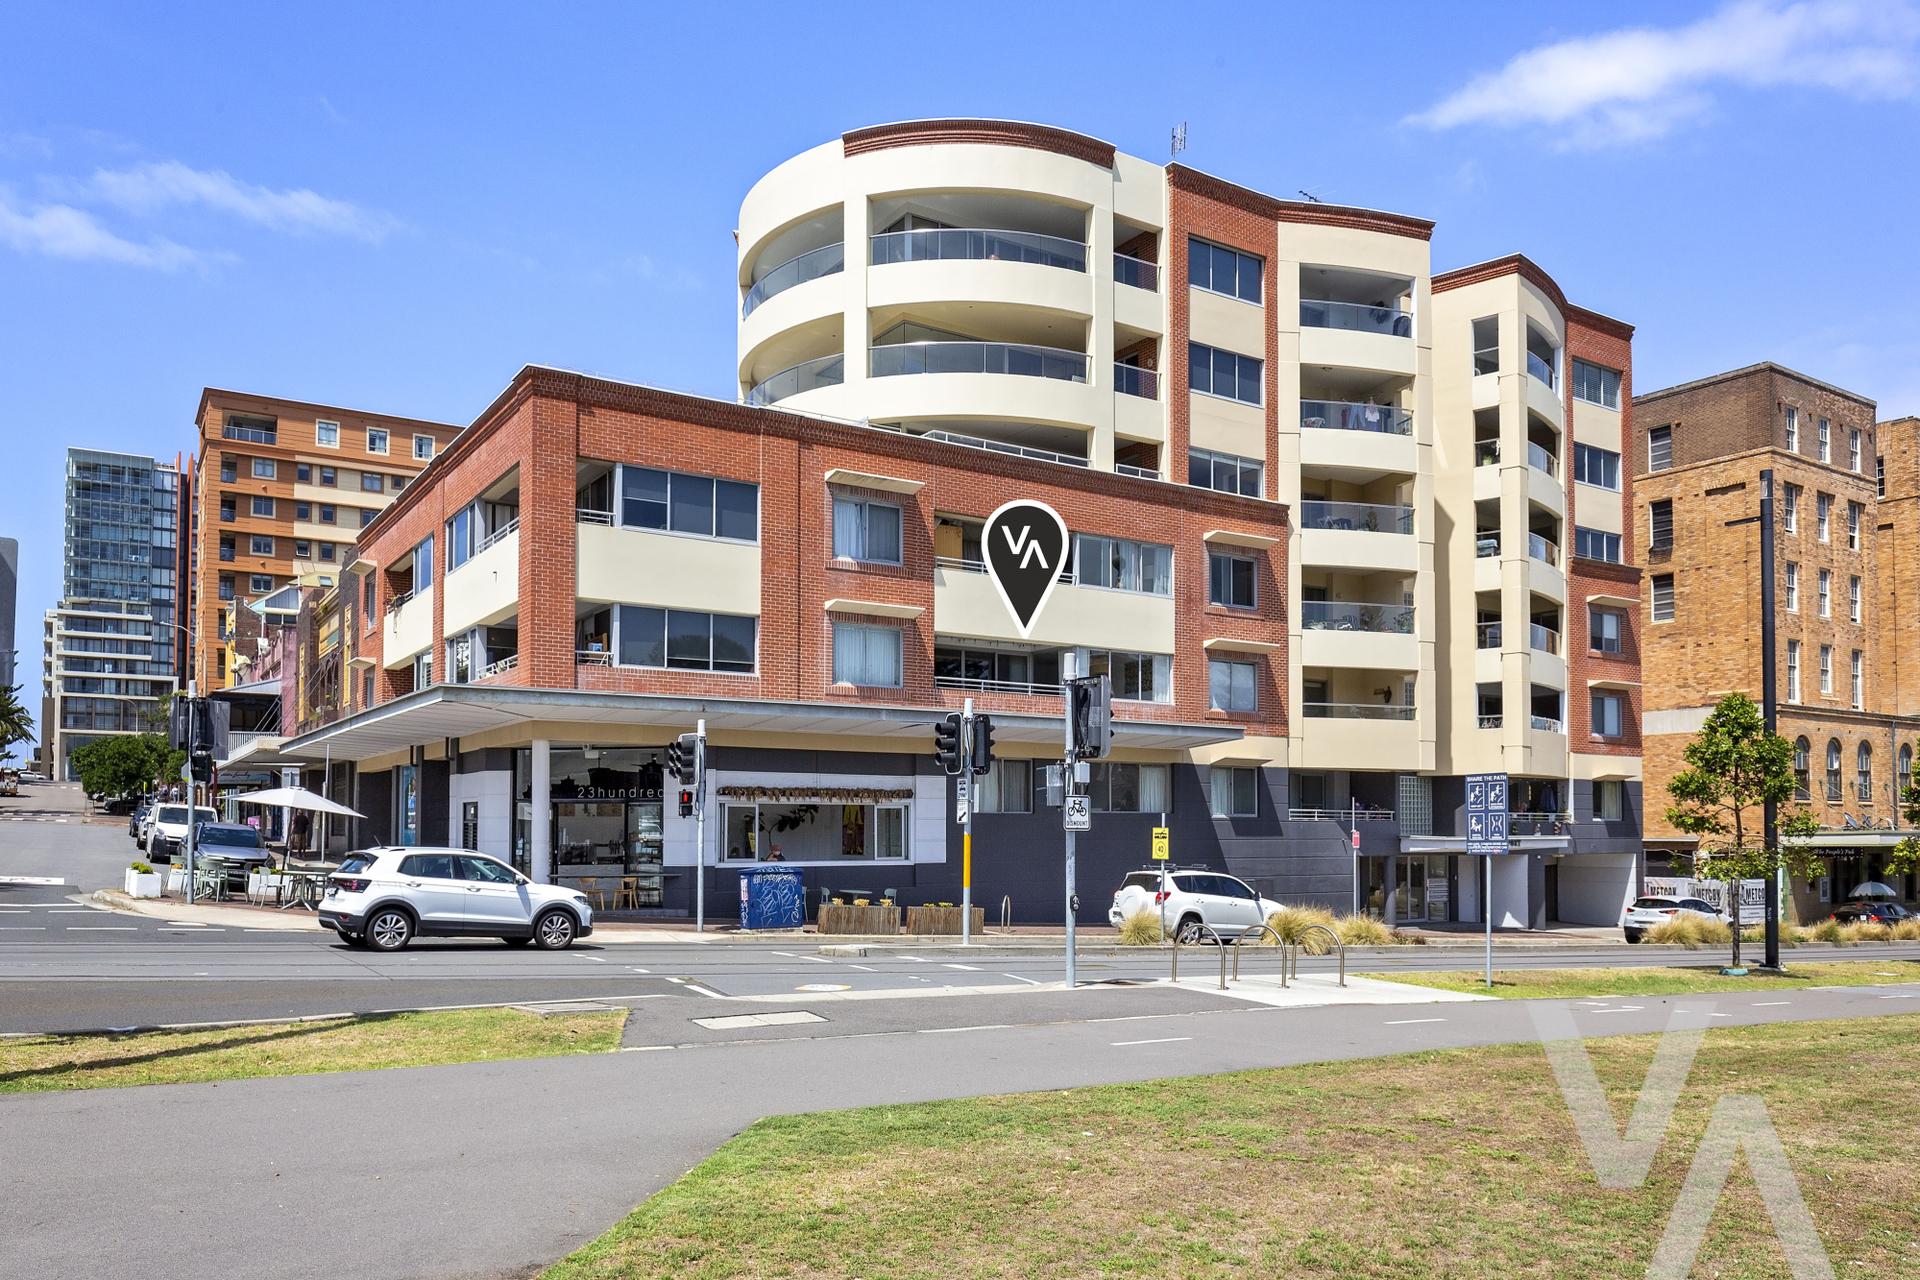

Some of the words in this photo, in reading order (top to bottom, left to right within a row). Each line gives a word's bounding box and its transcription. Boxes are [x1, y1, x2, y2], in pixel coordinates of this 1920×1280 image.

[1158, 845, 1164, 853] 40
[1825, 848, 1844, 856] People's
[1746, 888, 1765, 900] METCO
